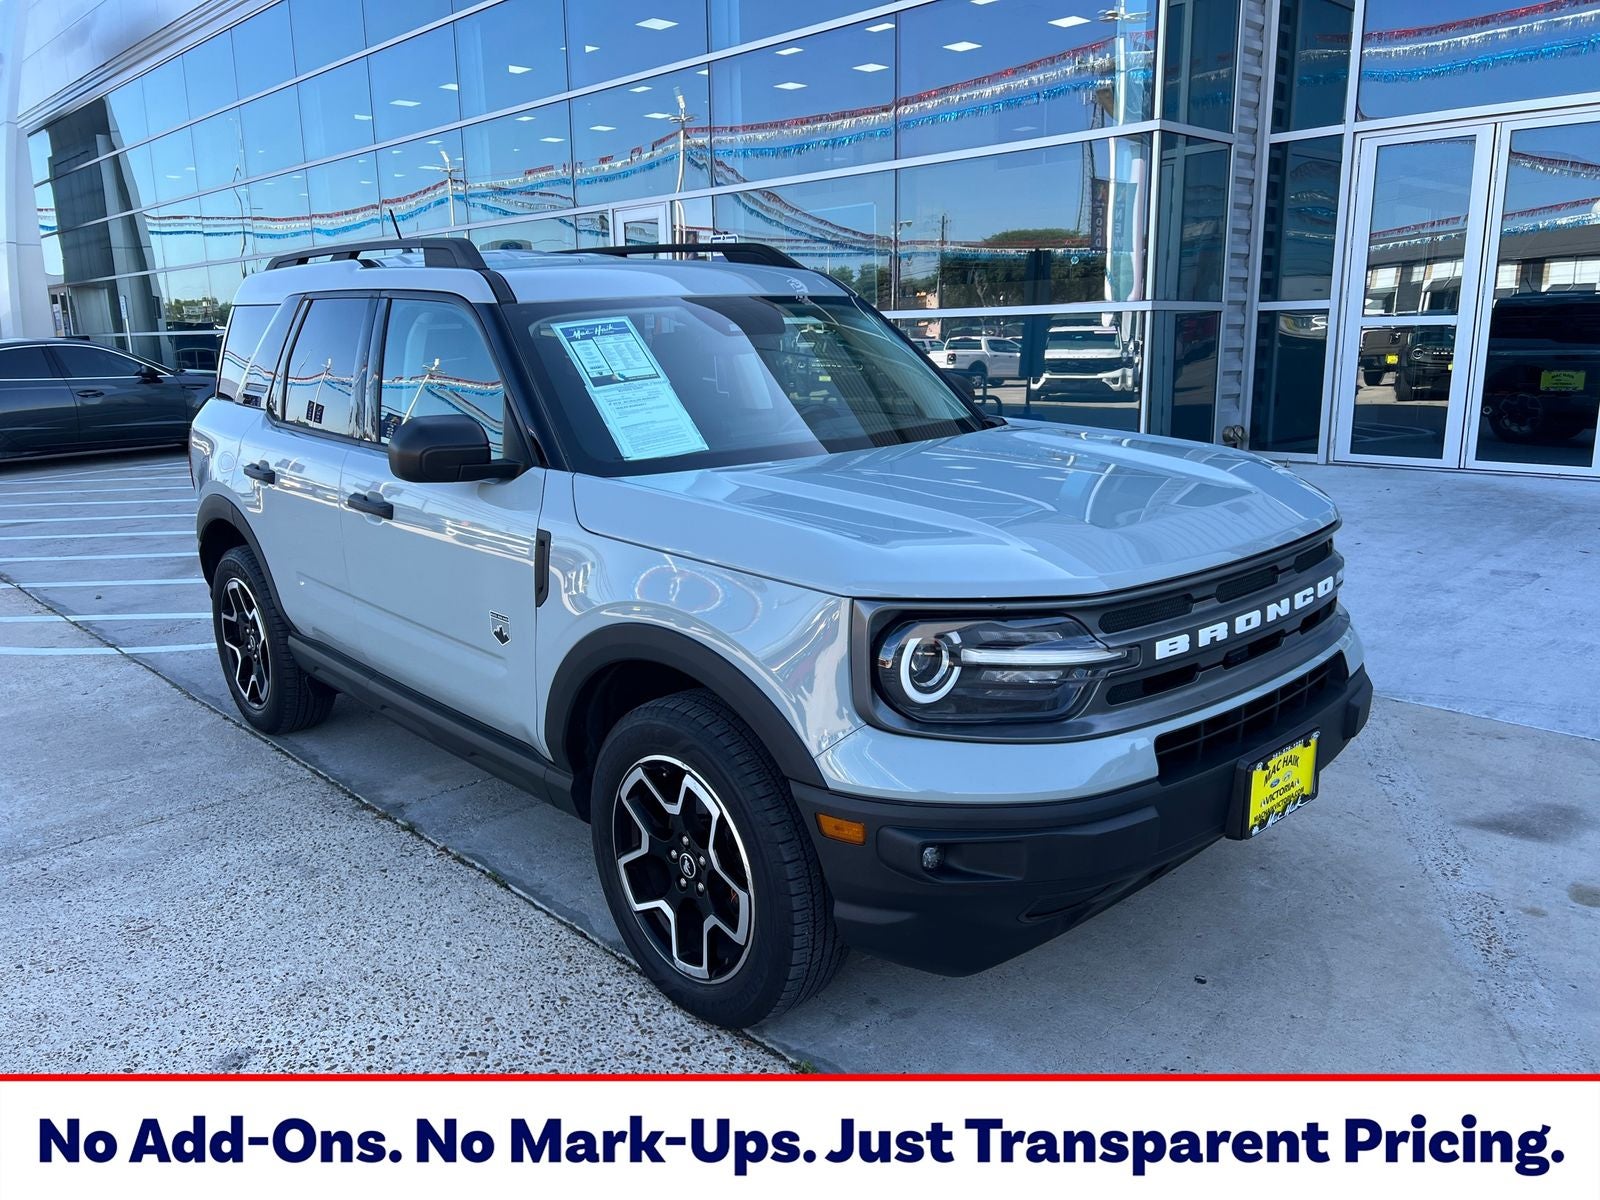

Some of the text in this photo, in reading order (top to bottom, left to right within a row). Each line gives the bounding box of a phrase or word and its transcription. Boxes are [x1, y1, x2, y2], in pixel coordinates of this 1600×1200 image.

[1155, 575, 1335, 660] BRONCO
[1264, 759, 1282, 787] MAC
[1282, 754, 1300, 768] HAIK
[1266, 781, 1297, 804] VICTORIA
